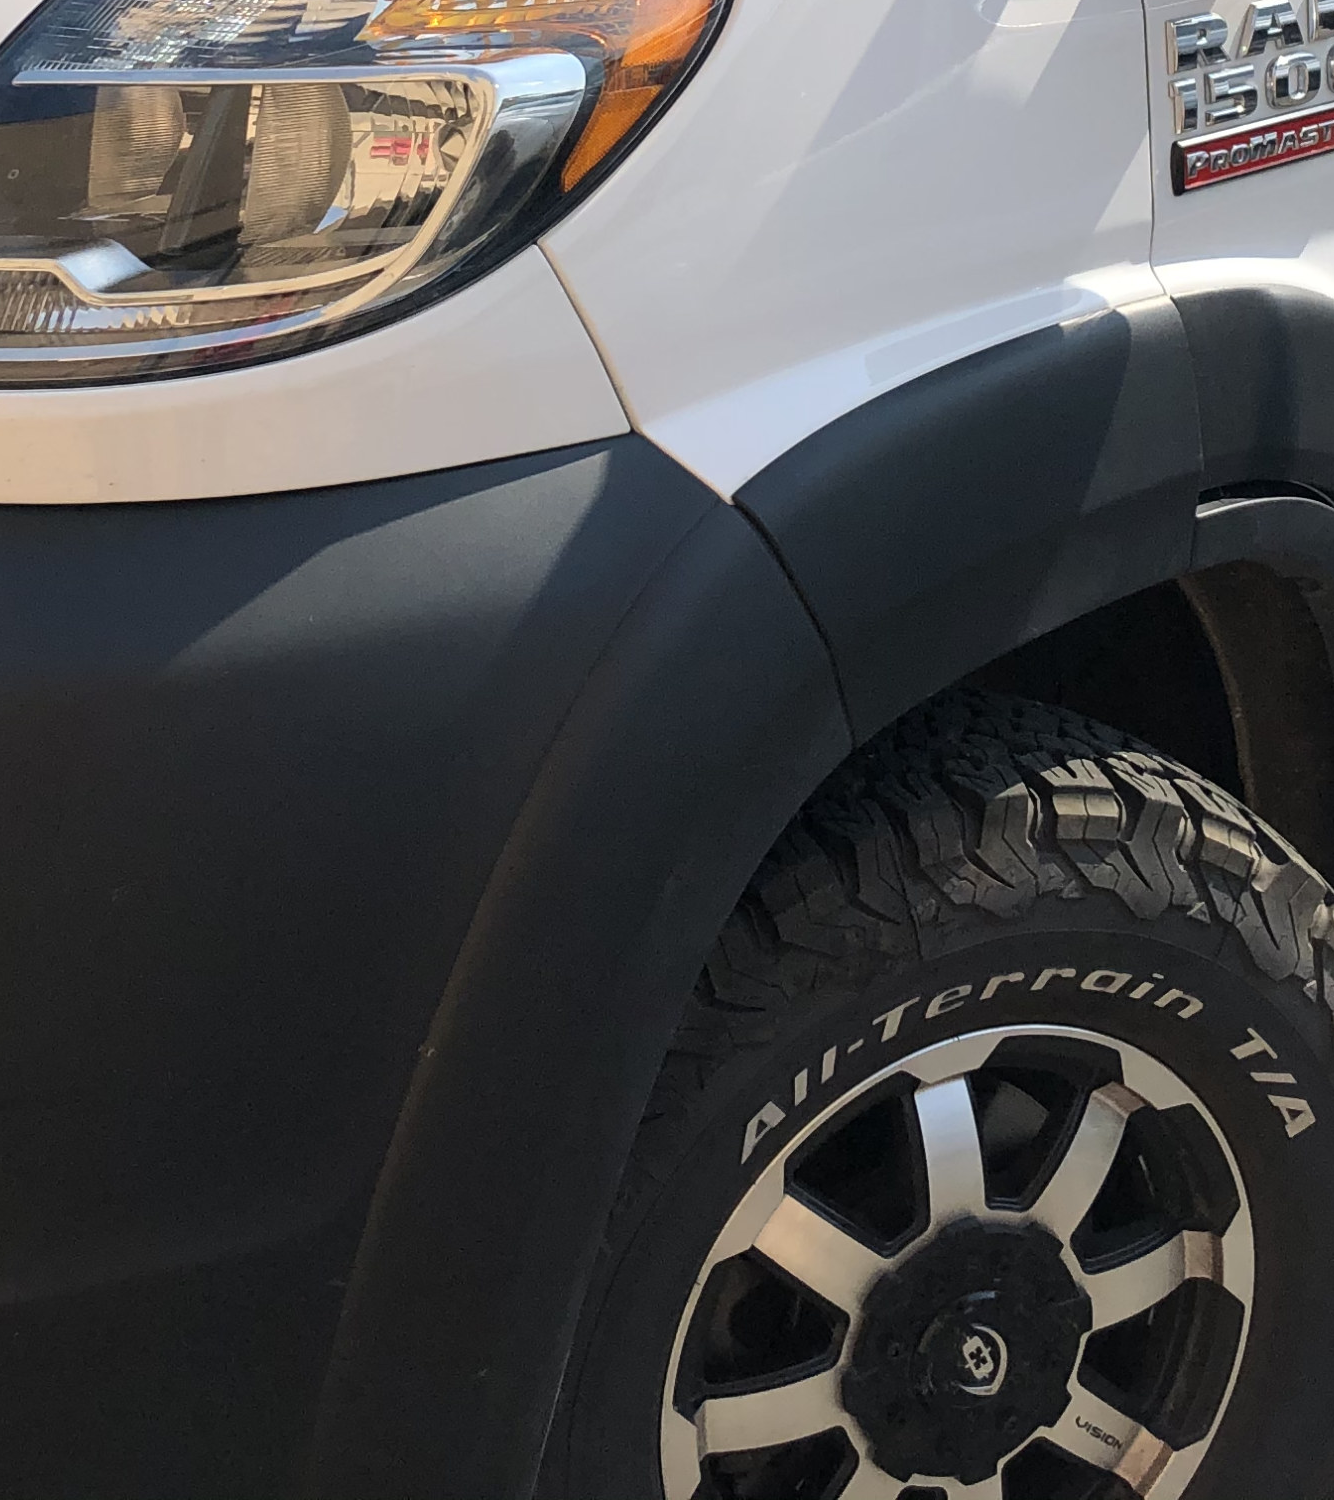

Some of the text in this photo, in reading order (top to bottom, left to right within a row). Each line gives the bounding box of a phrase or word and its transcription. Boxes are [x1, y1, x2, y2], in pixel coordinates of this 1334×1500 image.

[740, 966, 1316, 1165] All-Terrain T/A
[1075, 1415, 1124, 1449] VISION
